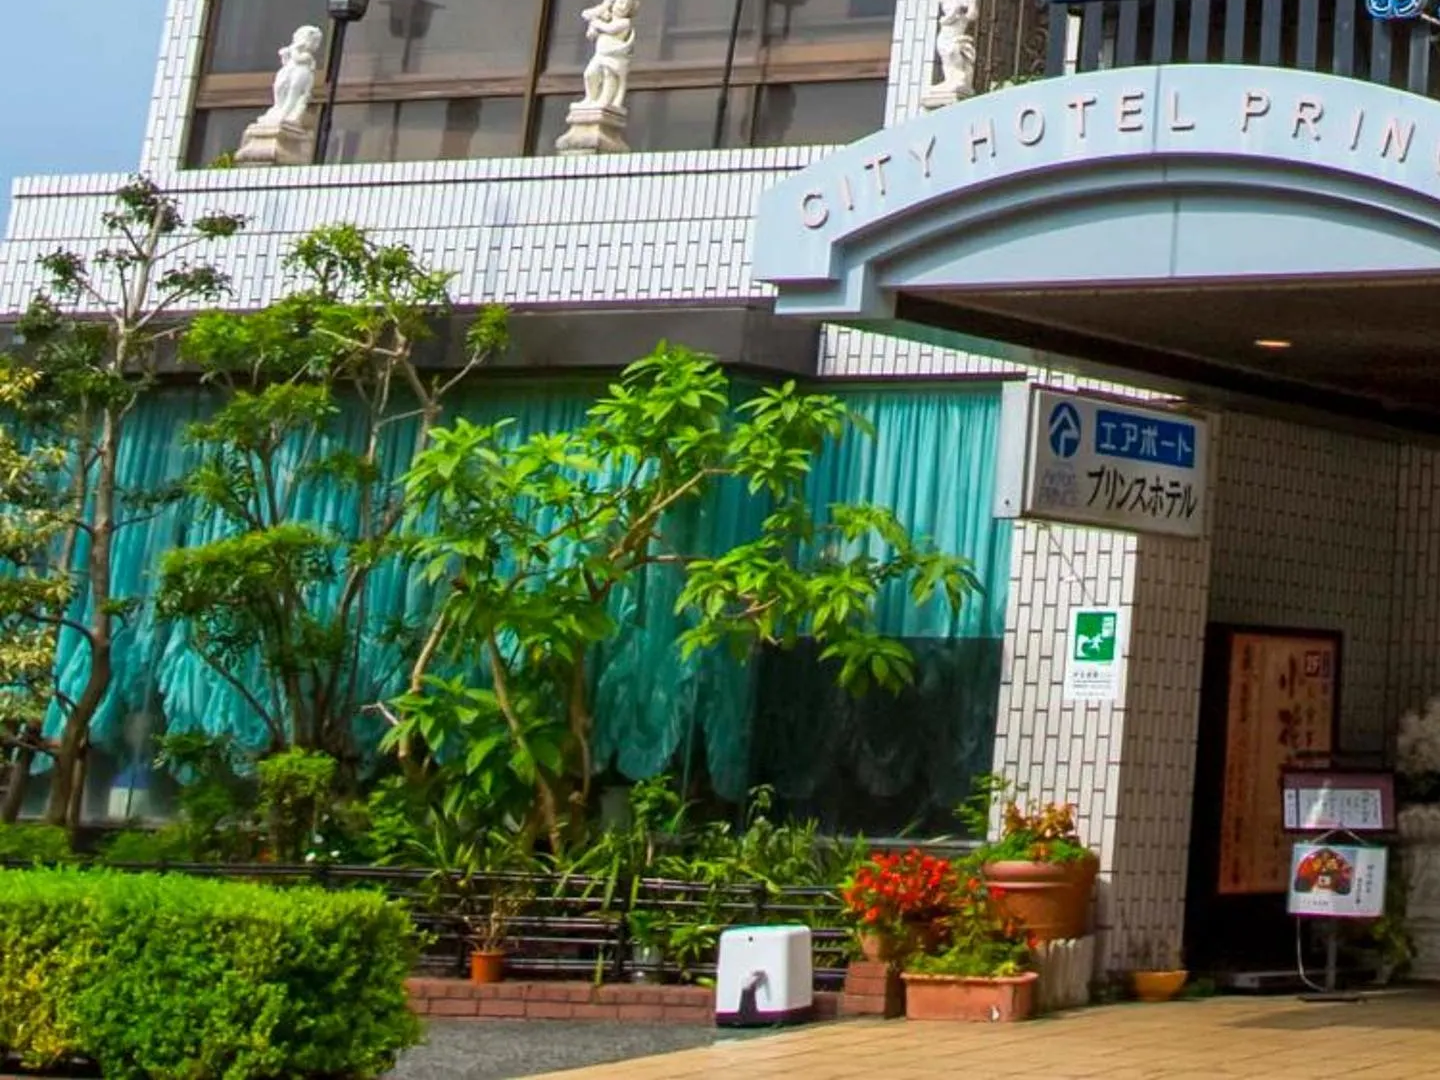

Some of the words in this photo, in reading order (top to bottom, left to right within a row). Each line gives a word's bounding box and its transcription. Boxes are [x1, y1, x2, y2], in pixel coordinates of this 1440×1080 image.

[799, 134, 938, 229] CITY
[967, 88, 1196, 164] HOTEL
[1098, 421, 1193, 463] エアポート
[1086, 465, 1199, 521] プリンスホテル
